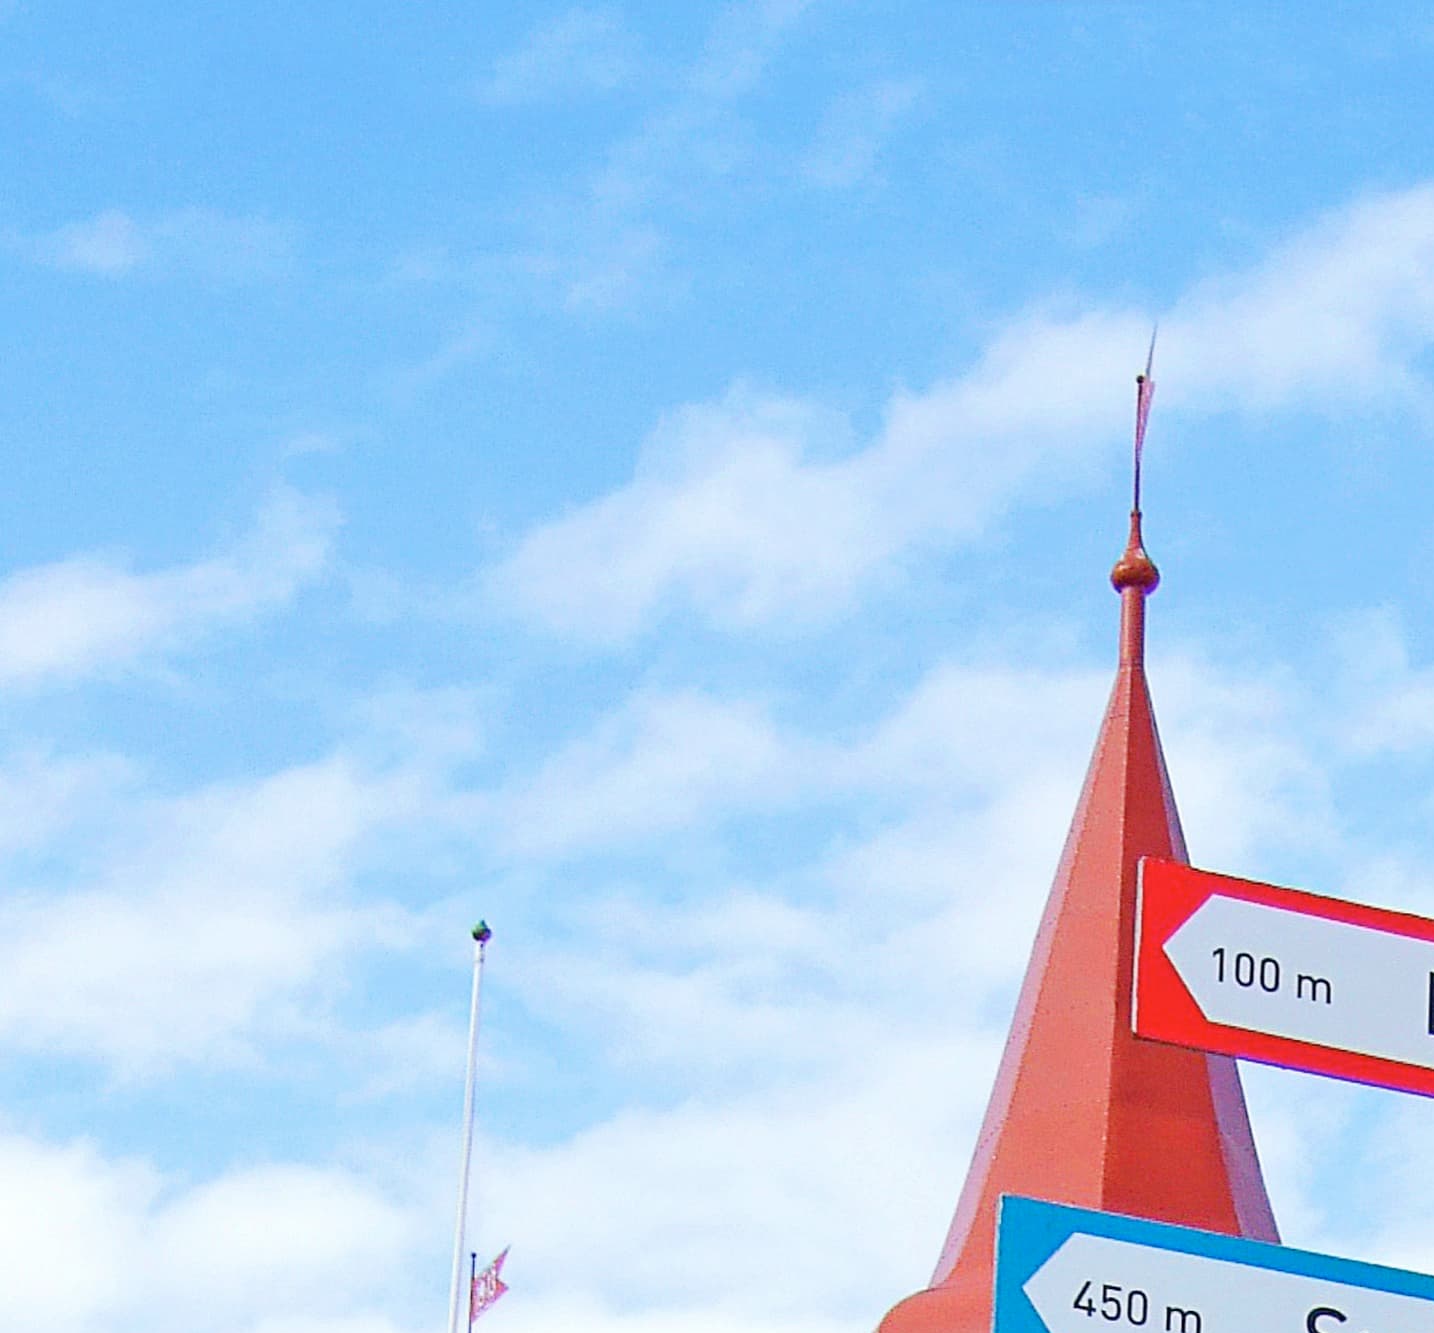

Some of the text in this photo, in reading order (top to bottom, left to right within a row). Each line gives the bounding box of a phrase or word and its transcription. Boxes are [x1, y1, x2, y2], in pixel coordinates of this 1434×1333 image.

[1212, 947, 1280, 993] 100
[1297, 973, 1332, 1005] m
[1073, 1280, 1148, 1326] 450
